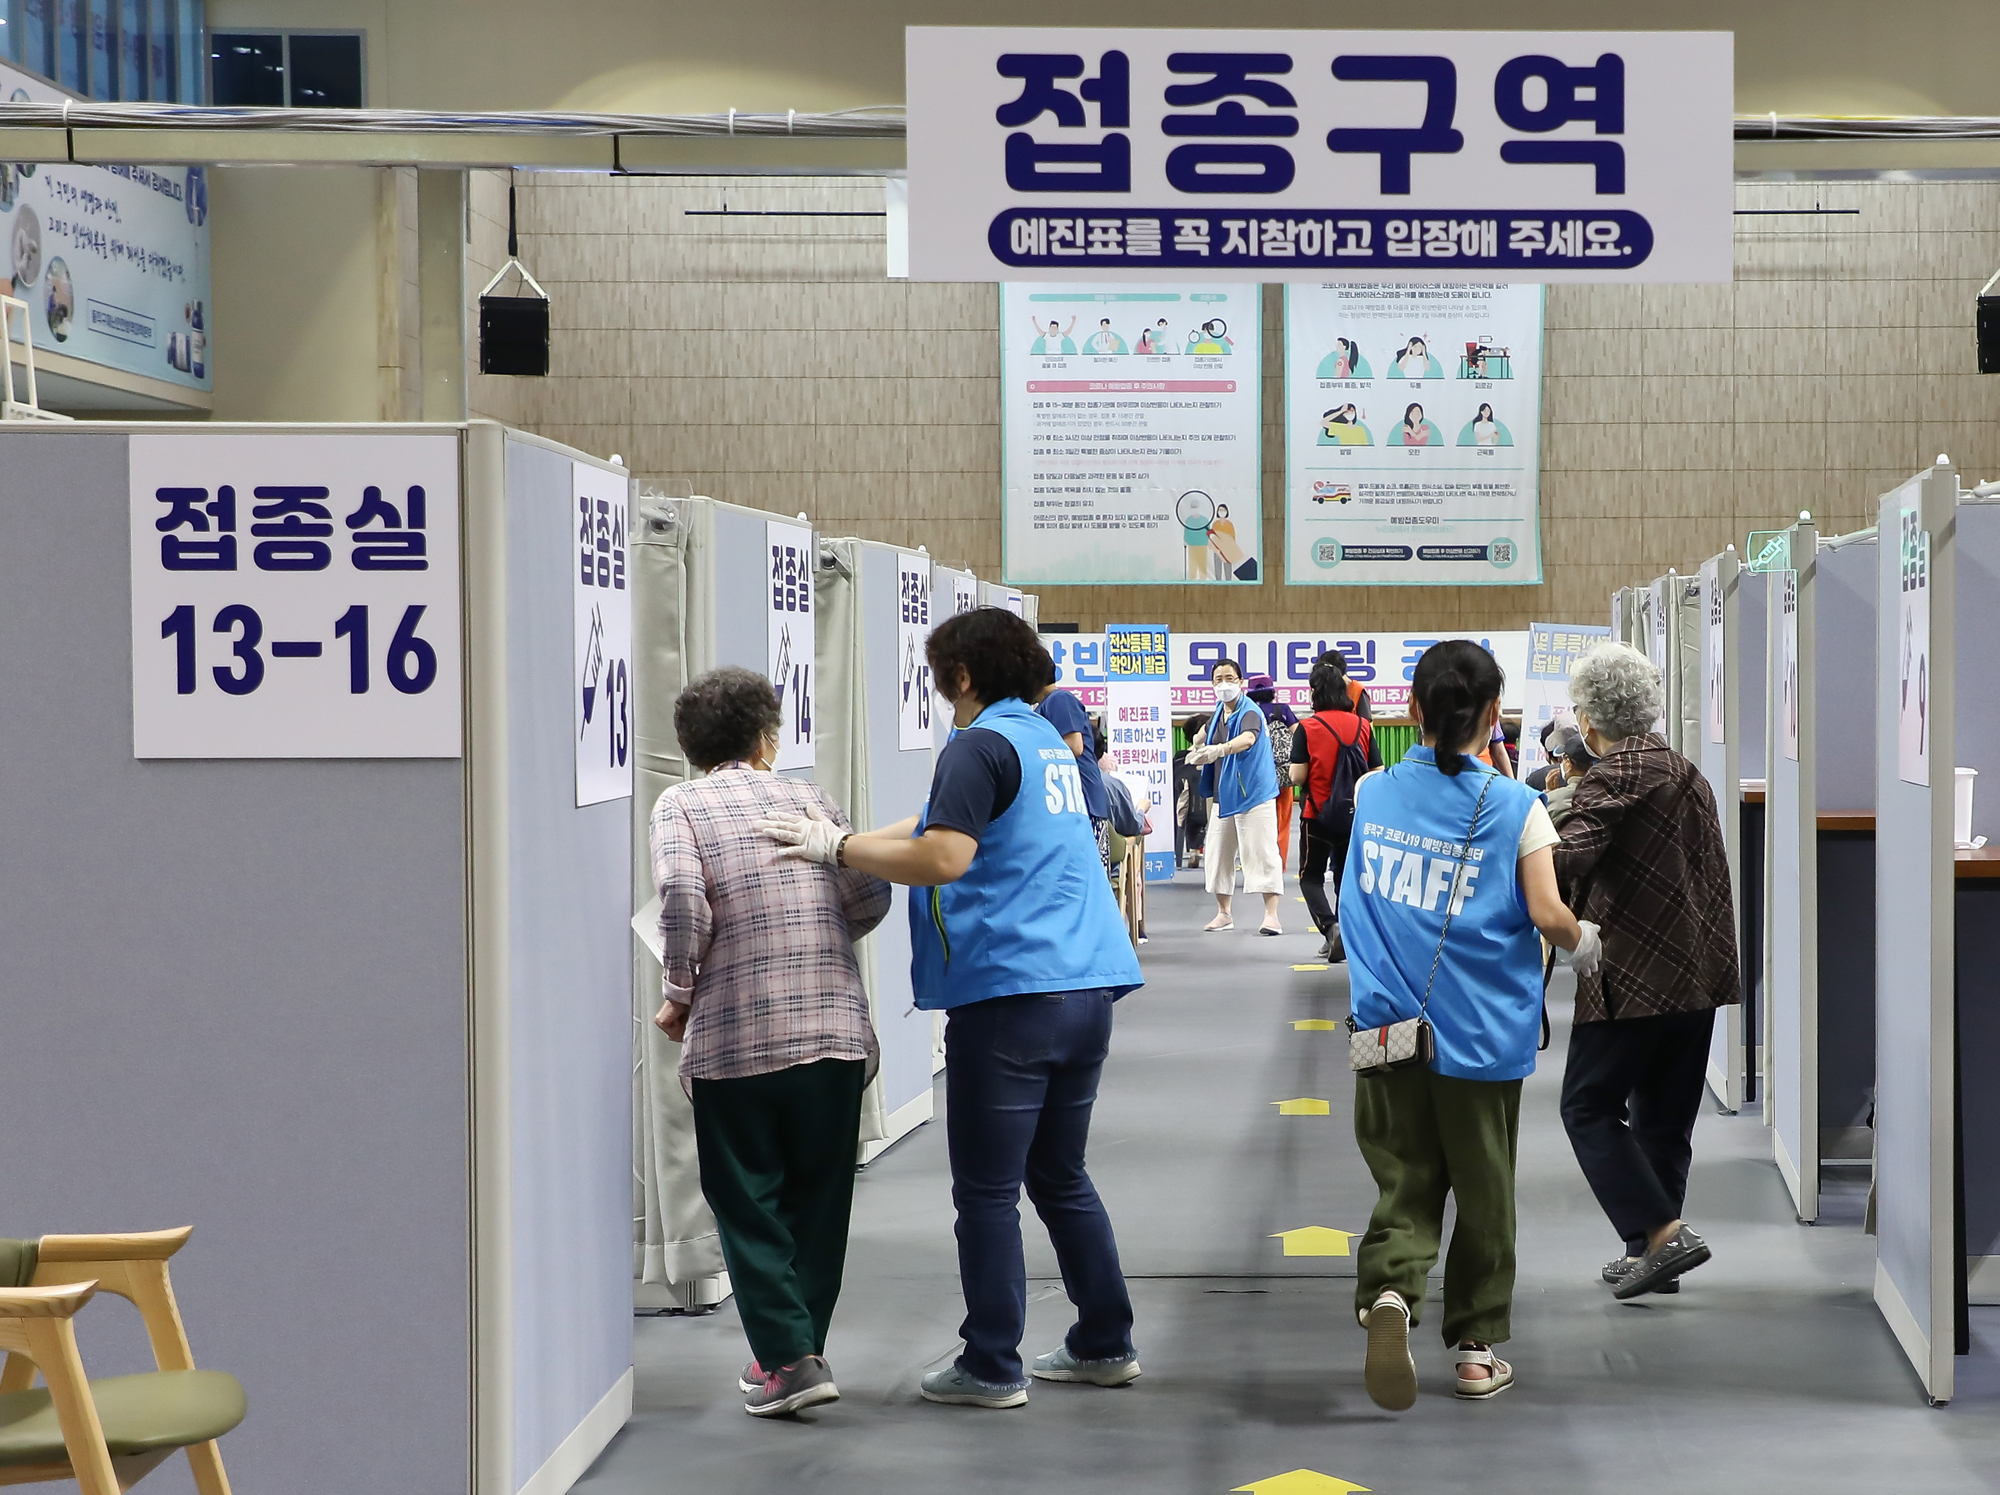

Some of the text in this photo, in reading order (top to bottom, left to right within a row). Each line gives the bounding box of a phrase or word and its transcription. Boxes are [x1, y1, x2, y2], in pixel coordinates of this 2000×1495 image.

[995, 49, 1626, 195] 접종구역
[1010, 218, 1632, 257] 예진표를 꼭 지참하고 입장해 주세요.
[155, 485, 430, 572] 접종실
[580, 496, 626, 591] 접종실
[1391, 516, 1440, 525] 예방접종도우미
[772, 545, 809, 613] 접종실
[901, 570, 928, 625] 접종실
[160, 603, 438, 696] 13-16
[1108, 632, 1166, 653] 전산등록 및
[1108, 654, 1143, 675] 확인서
[1144, 654, 1168, 675] 발급
[1187, 639, 1377, 683] 모니터링
[606, 658, 628, 769] 13
[792, 664, 812, 745] 14
[916, 665, 930, 730] 15
[1118, 706, 1160, 722] 예진표를
[1186, 690, 1214, 703] 반드
[1918, 653, 1927, 756] 9
[1112, 727, 1167, 744] 제출하신 후
[1145, 860, 1164, 873] 작구
[1363, 822, 1485, 862] 동작구 코로나19 예방접종센터
[1359, 839, 1481, 917] STAFF
